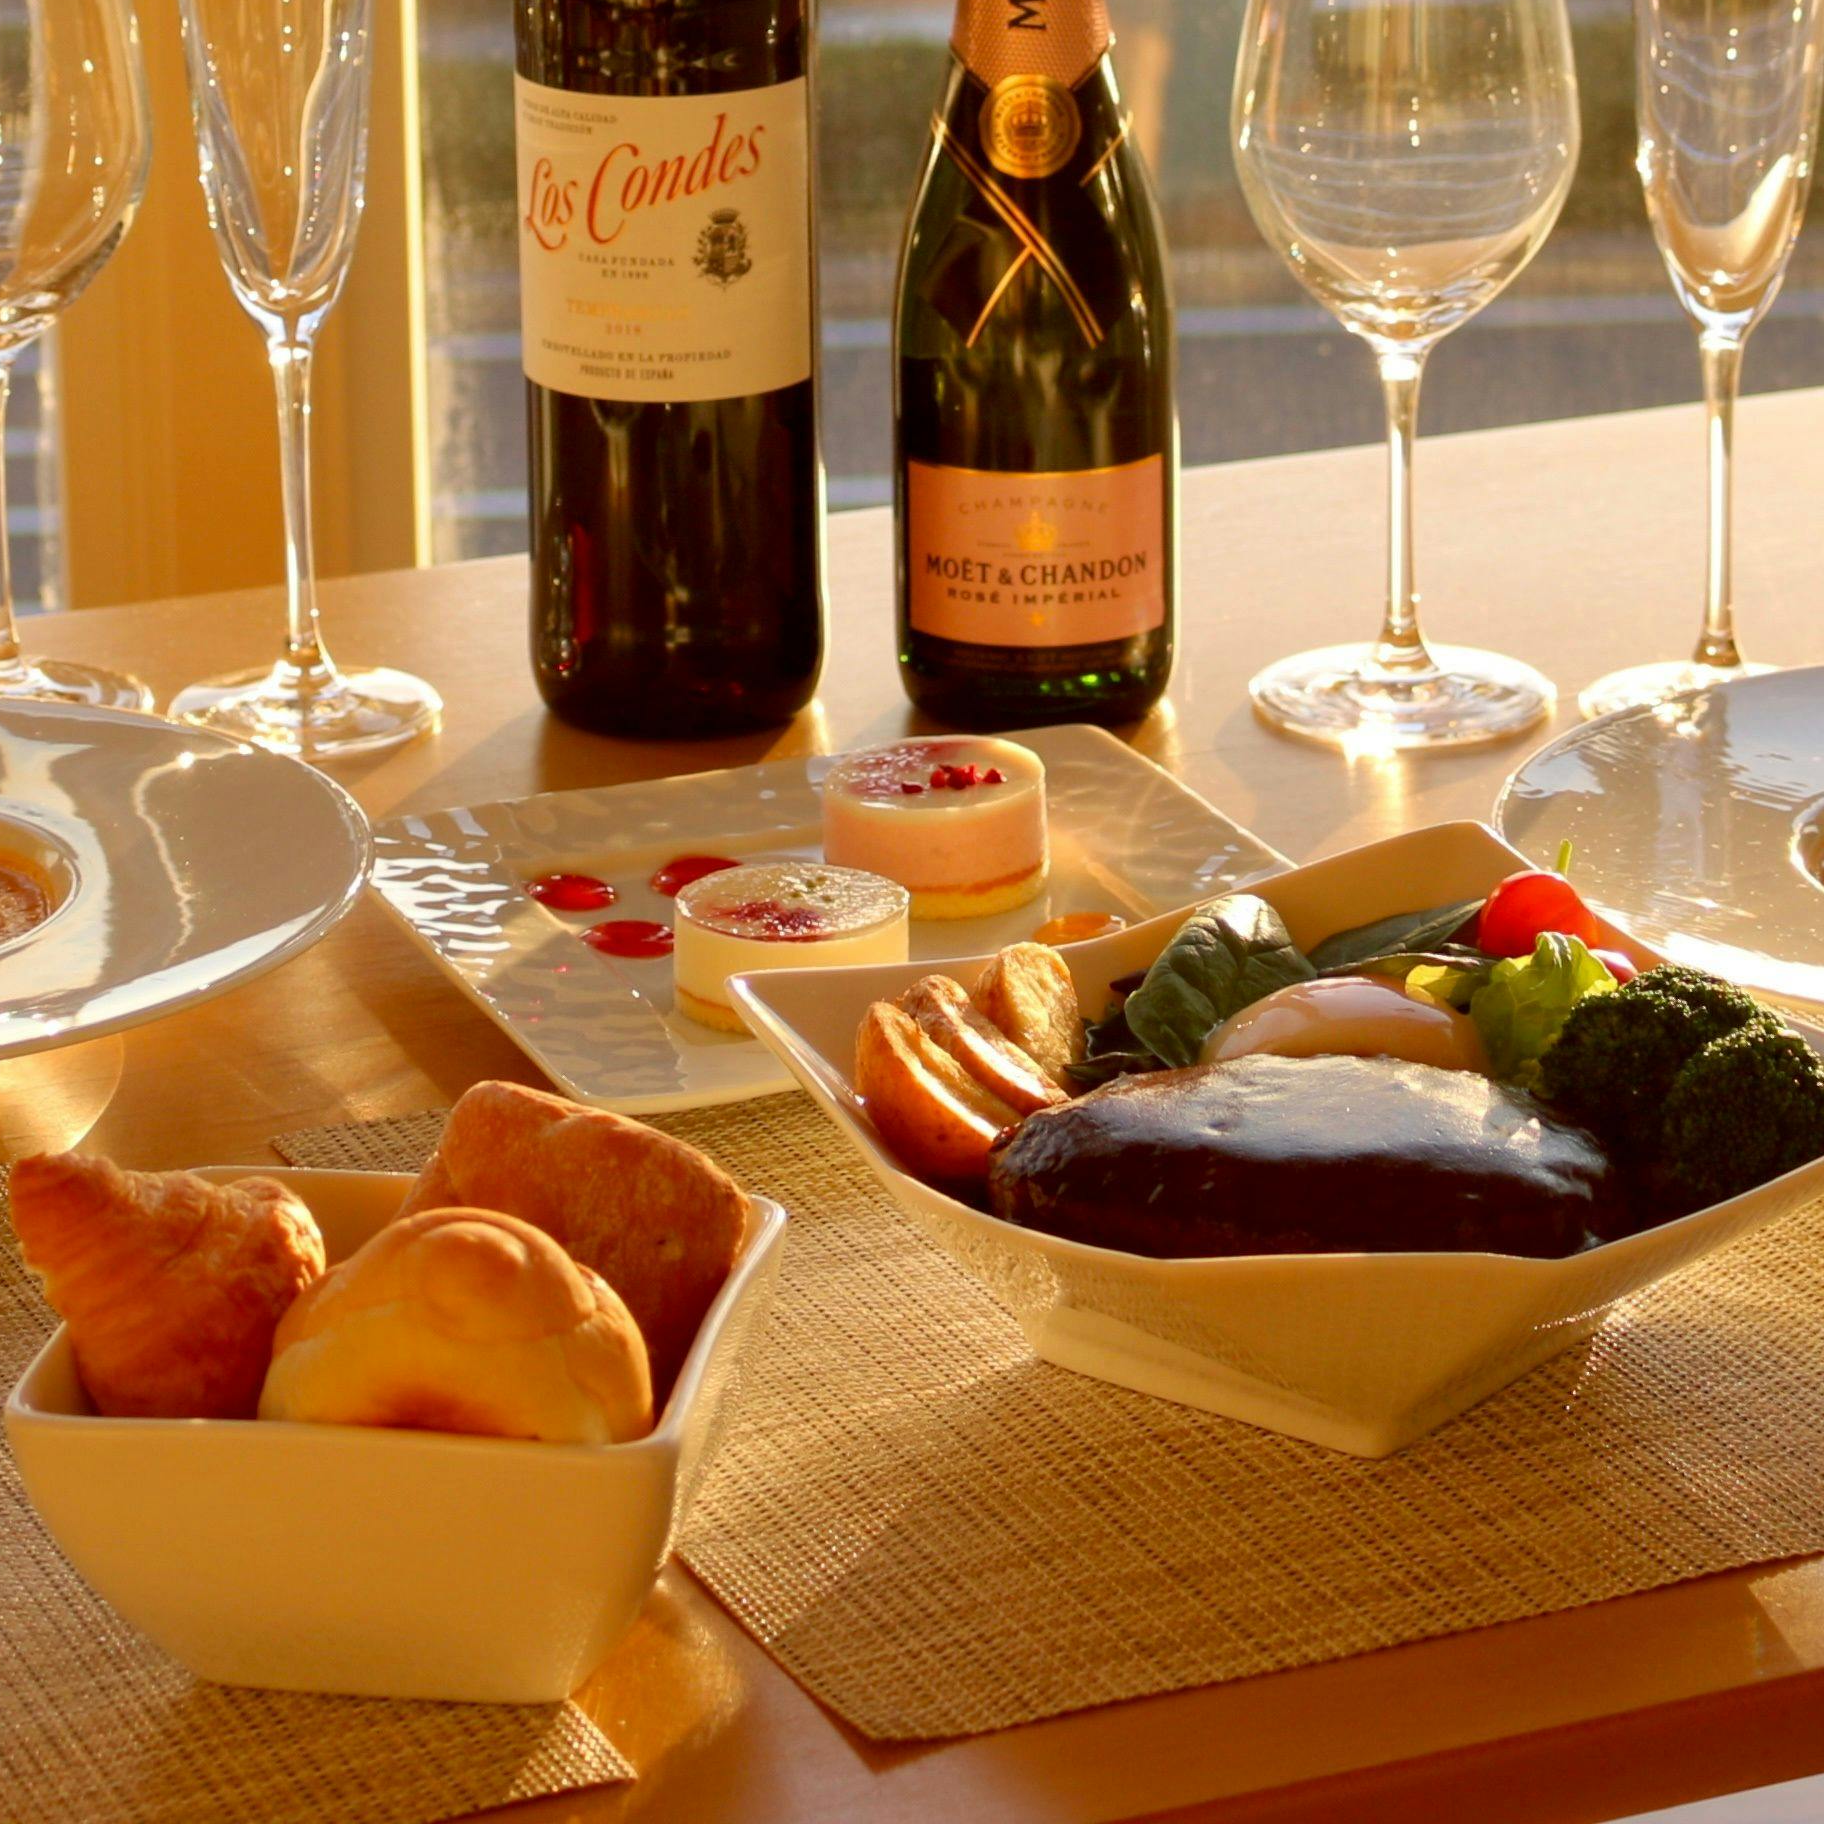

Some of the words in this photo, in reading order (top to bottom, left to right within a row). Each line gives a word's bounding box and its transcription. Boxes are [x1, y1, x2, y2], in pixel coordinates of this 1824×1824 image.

[525, 157, 579, 251] Los
[587, 112, 765, 245] Condes
[617, 351, 635, 362] EN
[638, 352, 654, 362] LA
[658, 349, 732, 363] PROPIEDAD
[958, 496, 1109, 515] CHAMPAGNE
[926, 553, 992, 584] MOËT
[997, 568, 1012, 585] &
[1020, 551, 1147, 586] CHANDON
[947, 587, 1000, 605] ROSÉ
[1013, 587, 1121, 606] IMPÉRIAL
